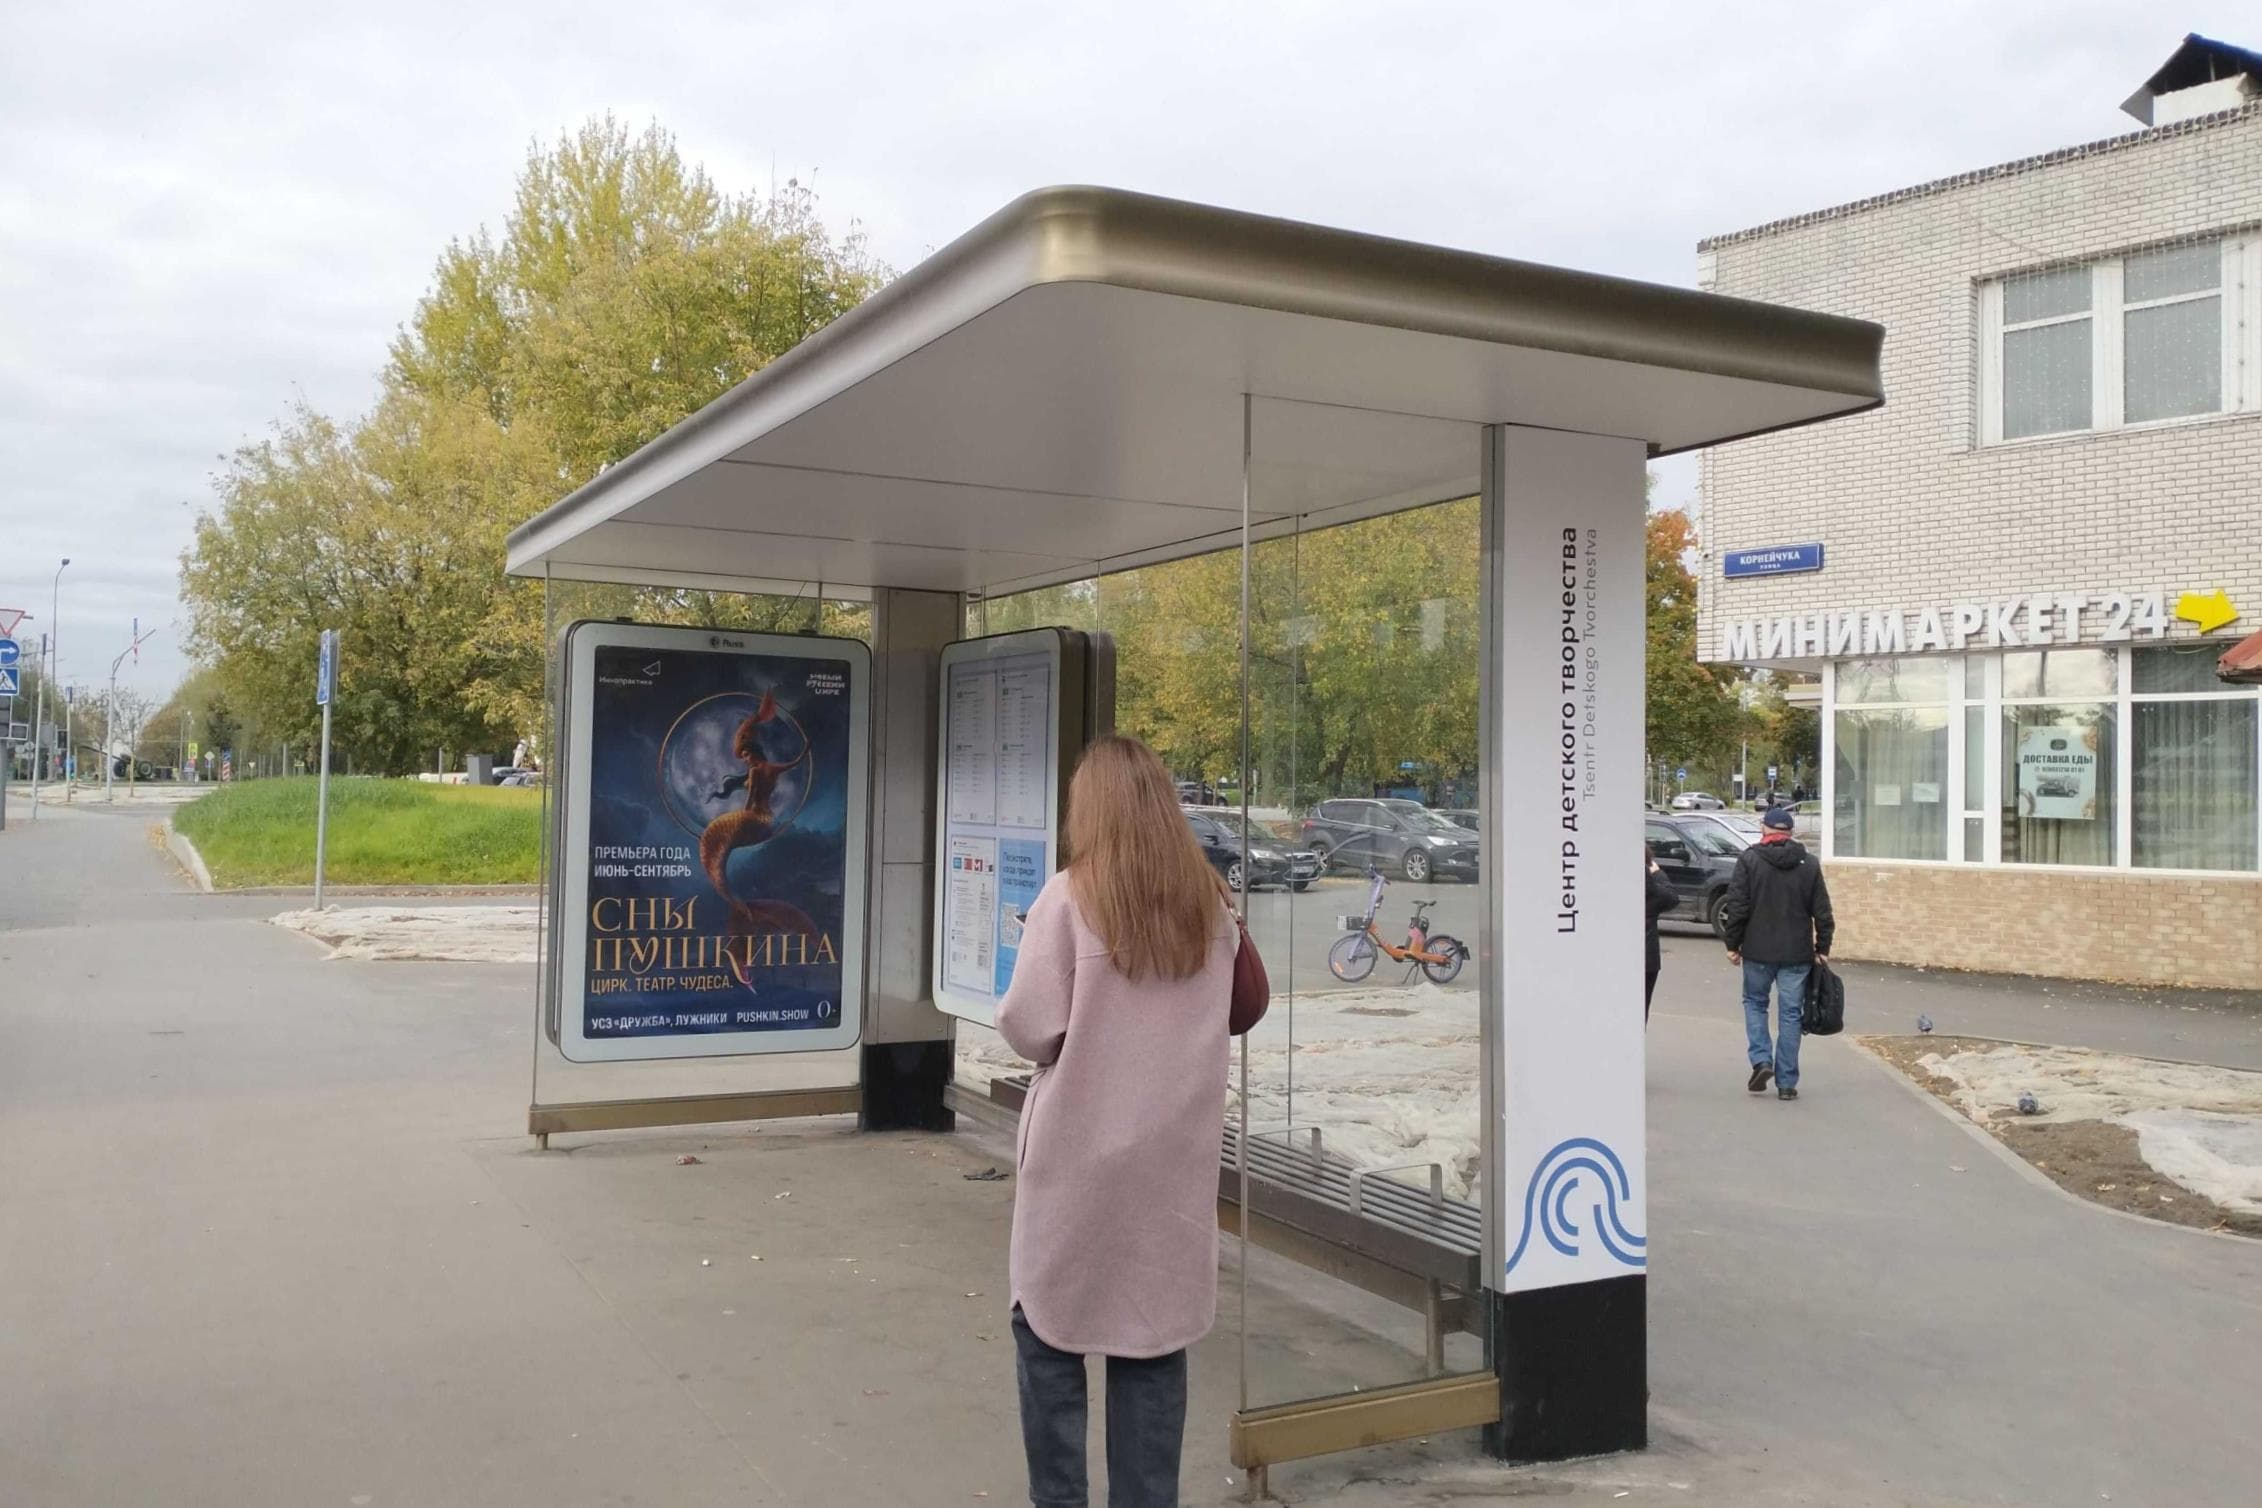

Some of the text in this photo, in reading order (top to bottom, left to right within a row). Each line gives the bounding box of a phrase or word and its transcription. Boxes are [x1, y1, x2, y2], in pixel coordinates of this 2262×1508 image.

[1740, 551, 1800, 565] КОРНЕЙЧУКА
[1722, 592, 2170, 662] МИНИМАРКЕТ 24
[1583, 529, 1599, 800] Tsentr Detskogo Tvorchestva
[1558, 527, 1580, 932] Центр детского творчества
[2023, 754, 2093, 765] ДОСТАВКА ЕДЫ
[595, 846, 691, 861] ПРЕМЬЕРА ГОДА
[594, 864, 692, 877] ИЮНЬ-СЕНТЯБРЬ
[592, 895, 699, 932] СНЫ
[592, 932, 839, 985] ПУШКИНА
[591, 979, 632, 995] ЦИРК.
[679, 975, 733, 991] ЧУДЕСА.
[675, 1012, 728, 1026] ЛУЖНИКИ
[737, 1009, 809, 1023] PUSHKIN.SHOW
